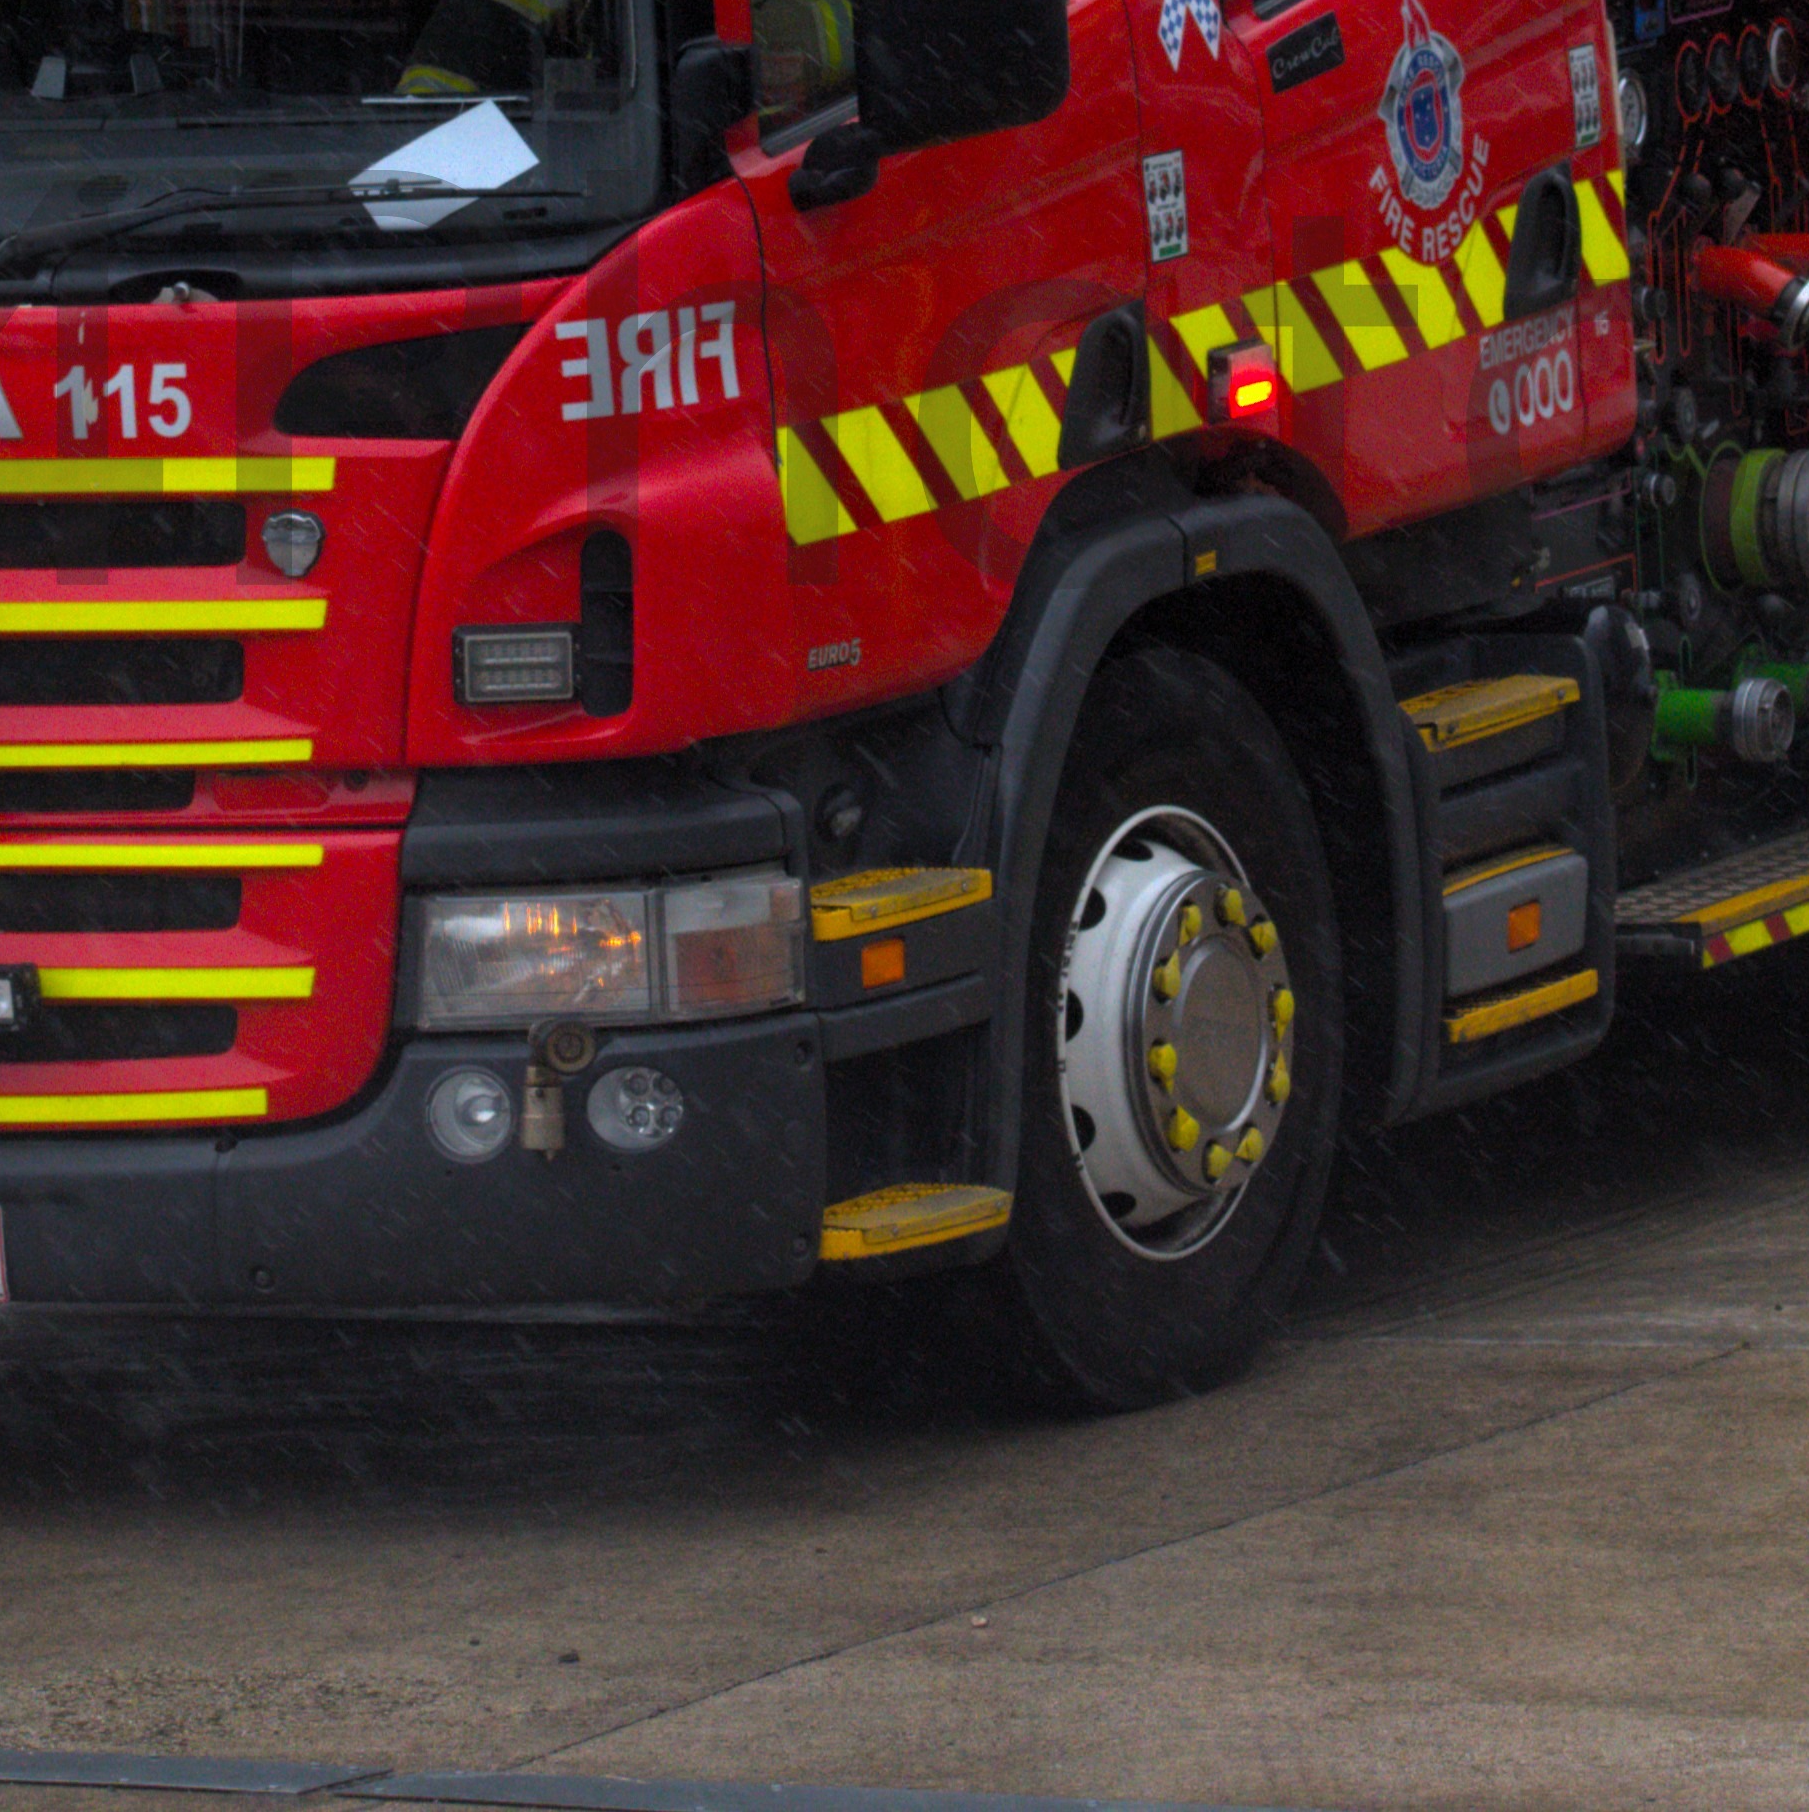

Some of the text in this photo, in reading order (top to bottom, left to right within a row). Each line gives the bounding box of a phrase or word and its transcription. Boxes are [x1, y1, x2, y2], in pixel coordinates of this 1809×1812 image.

[1369, 133, 1490, 263] FIRE RESCUE
[1479, 305, 1575, 370] EMERGENCY
[52, 363, 194, 441] 115
[1514, 349, 1574, 427] 000
